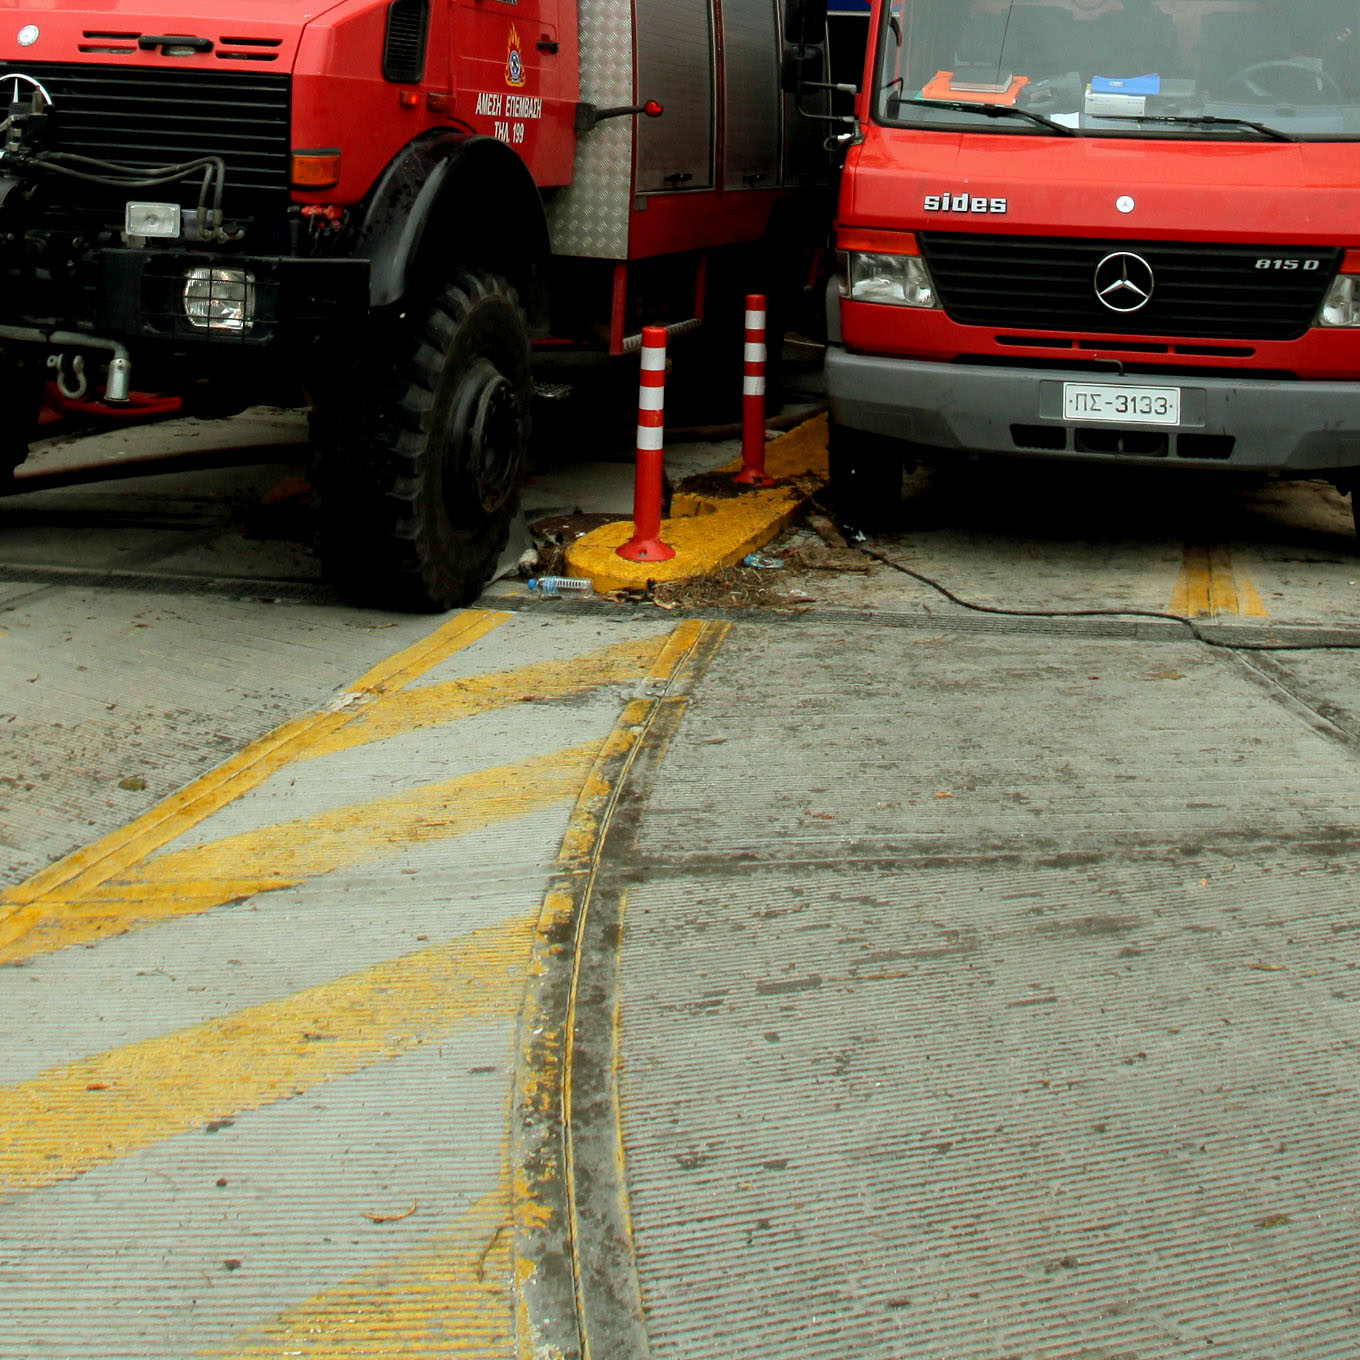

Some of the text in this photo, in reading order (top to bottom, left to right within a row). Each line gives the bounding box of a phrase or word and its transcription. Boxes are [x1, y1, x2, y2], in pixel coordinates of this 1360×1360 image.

[475, 92, 542, 119] ΑΜΕΣΗ ΕΠΕΜΒΑΣΗ
[513, 122, 525, 143] 199
[924, 192, 1007, 213] sides
[1255, 259, 1319, 270] 815 D
